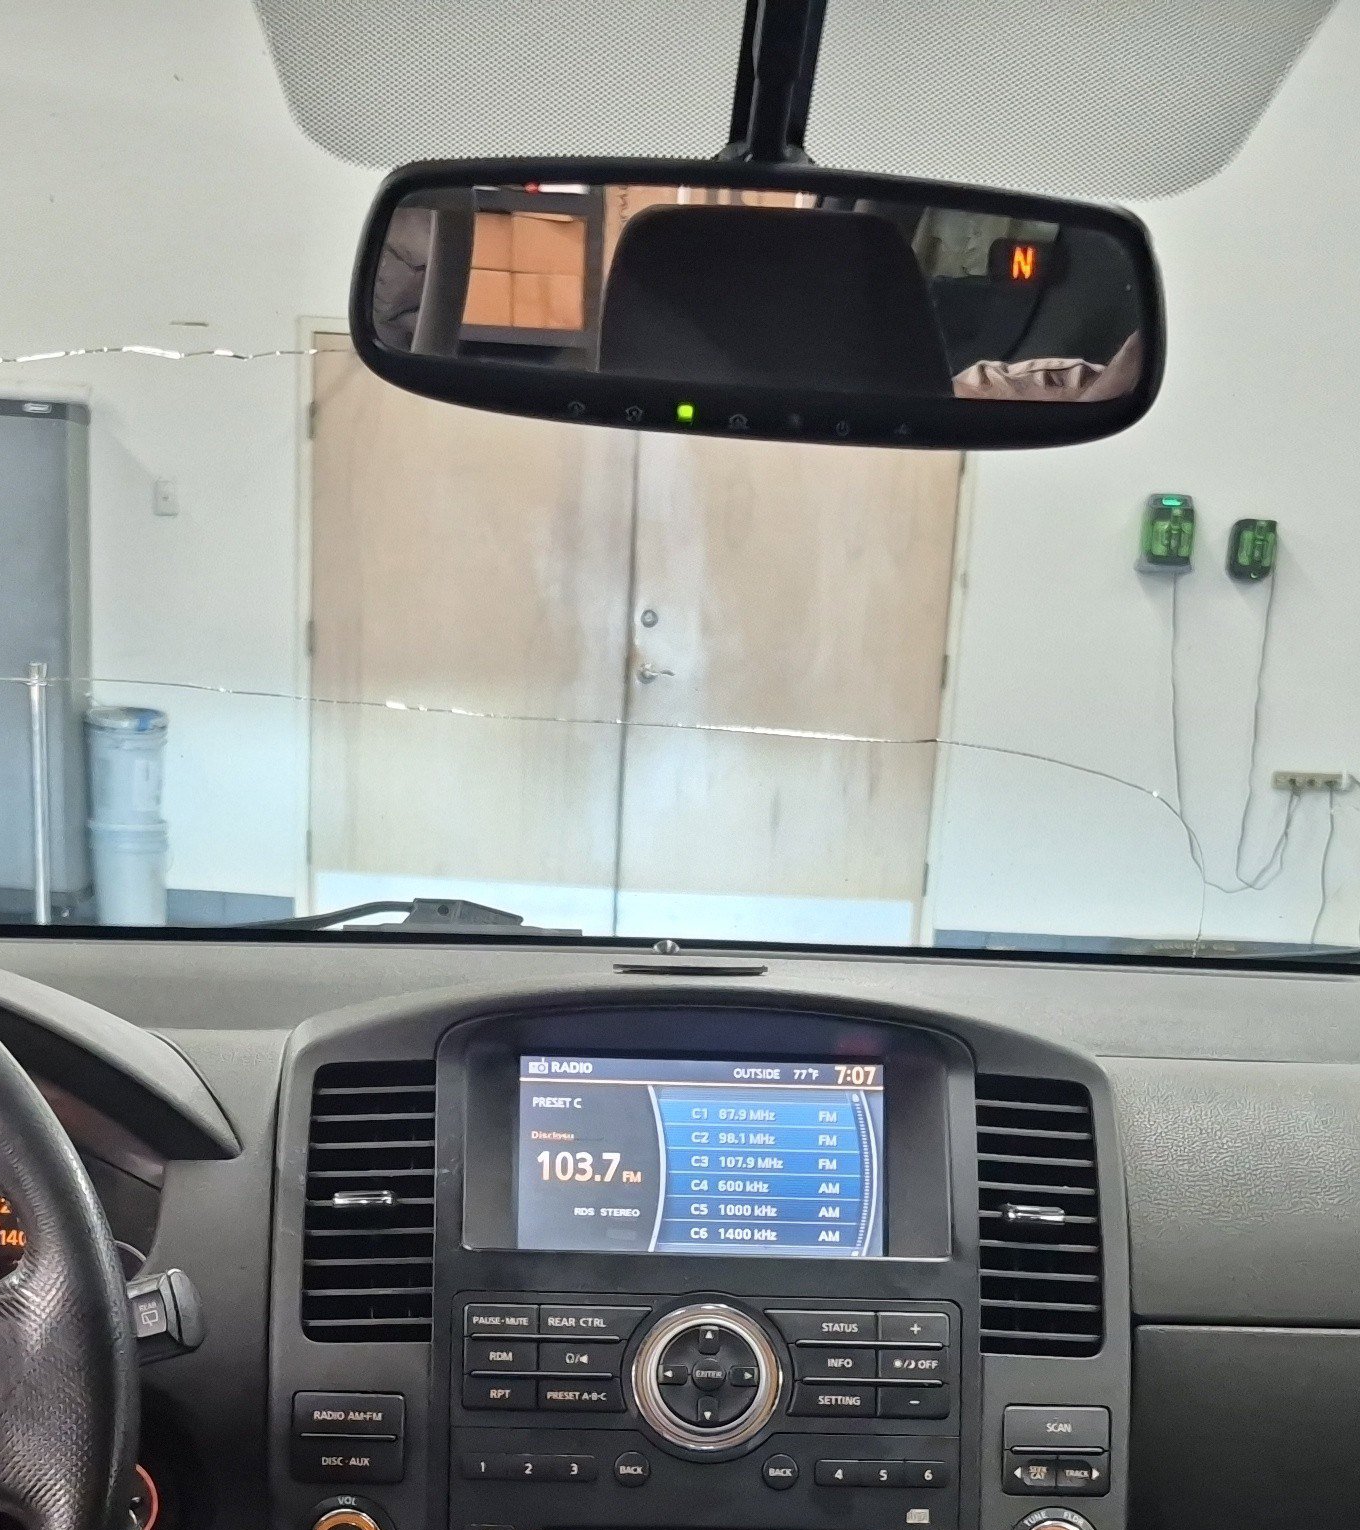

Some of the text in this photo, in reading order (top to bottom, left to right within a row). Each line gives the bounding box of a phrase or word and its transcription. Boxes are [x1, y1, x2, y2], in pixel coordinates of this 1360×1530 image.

[1012, 246, 1033, 279] N
[551, 1061, 593, 1074] RADIO
[733, 1068, 781, 1080] OUTSIDE
[834, 1065, 876, 1086] 7:07
[532, 1096, 582, 1109] PRESET C
[691, 1108, 837, 1123] C1 87.9 MHz FM
[691, 1132, 837, 1147] C2 98.1 MHz FM
[537, 1150, 642, 1183] 103.7 FM
[691, 1156, 837, 1171] C3 107.9 MHz FM
[690, 1179, 840, 1194] C4 600 kHz AM
[574, 1207, 640, 1218] RDS STEREO
[690, 1203, 840, 1218] C5 1000 kHz AM
[0, 1229, 27, 1246] 140
[690, 1227, 840, 1242] C6 1400 kHz AM
[547, 1317, 607, 1328] REAR CTRL
[821, 1322, 859, 1333] STATUS
[488, 1351, 513, 1362] RDM
[827, 1358, 853, 1368] INFO
[917, 1359, 939, 1370] OFF
[695, 1369, 723, 1379] ENTER
[489, 1388, 511, 1399] RPT
[546, 1391, 580, 1401] PRESET
[817, 1395, 861, 1406] SETTING
[313, 1410, 345, 1421] RADIO
[1046, 1422, 1073, 1433] SCAN
[480, 1461, 486, 1473] 1
[524, 1462, 533, 1475] 2
[569, 1463, 579, 1475] 3
[619, 1465, 644, 1475] BACK
[768, 1467, 793, 1477] BACK
[1065, 1469, 1089, 1477] TRACK
[834, 1468, 844, 1481] 4
[878, 1469, 888, 1481] 5
[924, 1469, 933, 1481] 6
[337, 1496, 358, 1506] VOL
[1023, 1510, 1085, 1527] TUNE FLDR
